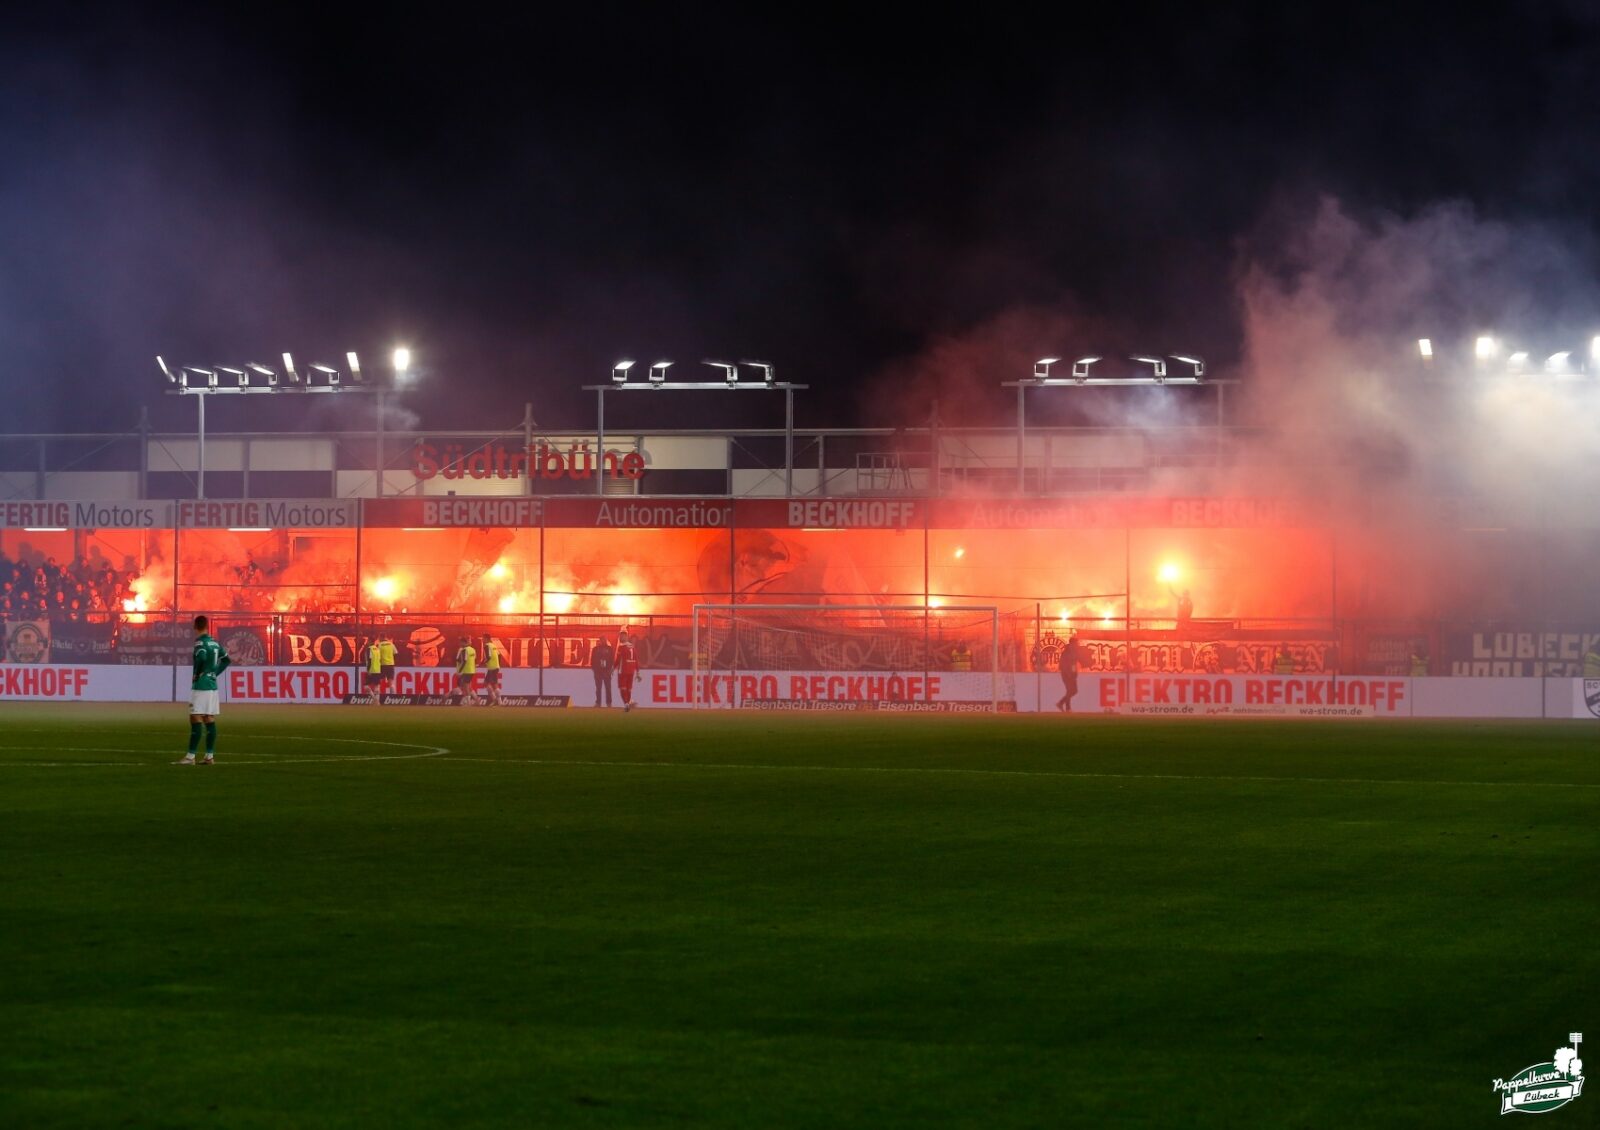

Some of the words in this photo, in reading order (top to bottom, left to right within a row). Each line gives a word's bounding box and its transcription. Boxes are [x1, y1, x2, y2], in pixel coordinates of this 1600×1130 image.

[410, 443, 645, 480] Südtribüne
[75, 503, 153, 527] Motors
[180, 503, 259, 526] FERTIG
[266, 503, 346, 526] Motors
[423, 502, 541, 526] BECKHOFF
[788, 502, 914, 526] BECKHOFF
[231, 671, 349, 699] ELEKTRO
[790, 675, 941, 702] BECKHOFF
[384, 695, 412, 706] bwin
[425, 696, 453, 706] bwn
[502, 696, 528, 706] bwin
[535, 697, 562, 707] bwin
[1246, 679, 1404, 710] BECKHOFF
[741, 698, 808, 710] Eisenbach
[811, 699, 857, 711] Tresore
[878, 700, 945, 712] Eisenbach
[1131, 706, 1194, 716] wa-strom.de
[1299, 707, 1363, 716] wa-strom.de
